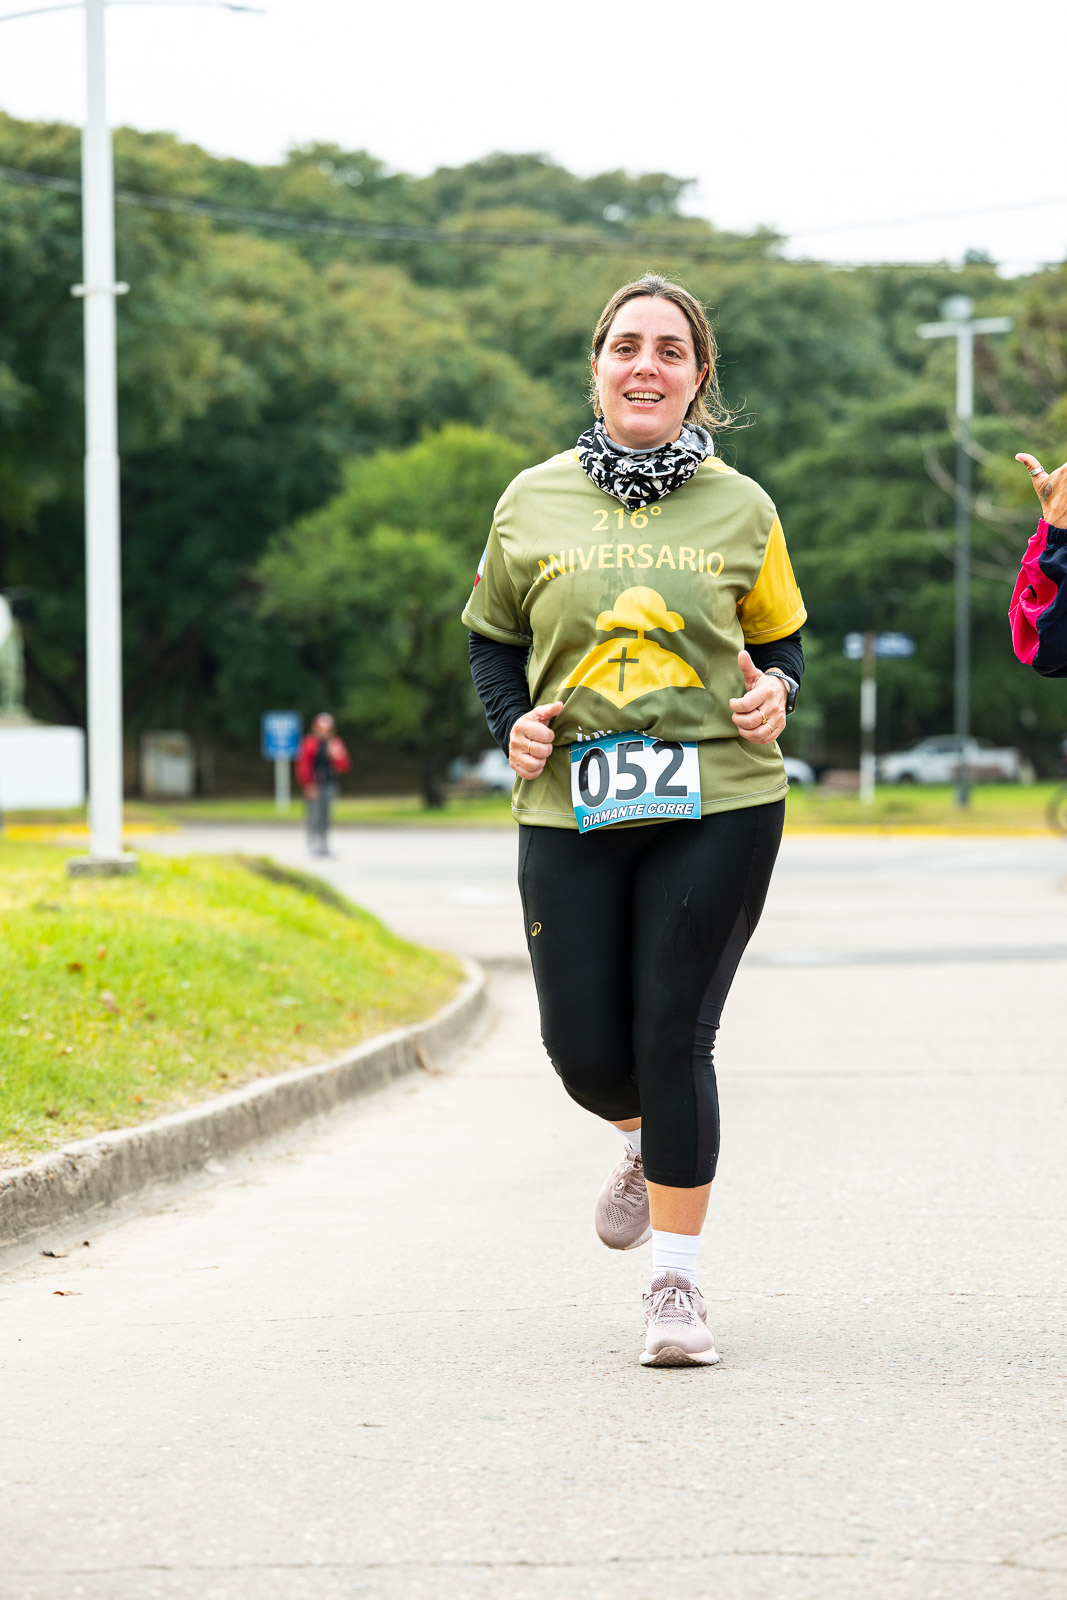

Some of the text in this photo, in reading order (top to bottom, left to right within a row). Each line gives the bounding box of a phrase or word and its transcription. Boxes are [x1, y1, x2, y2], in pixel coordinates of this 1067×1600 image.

[535, 543, 725, 585] ANIVERSARIO
[578, 740, 688, 808] 052
[582, 803, 694, 828] DIAMANTE CORRE
